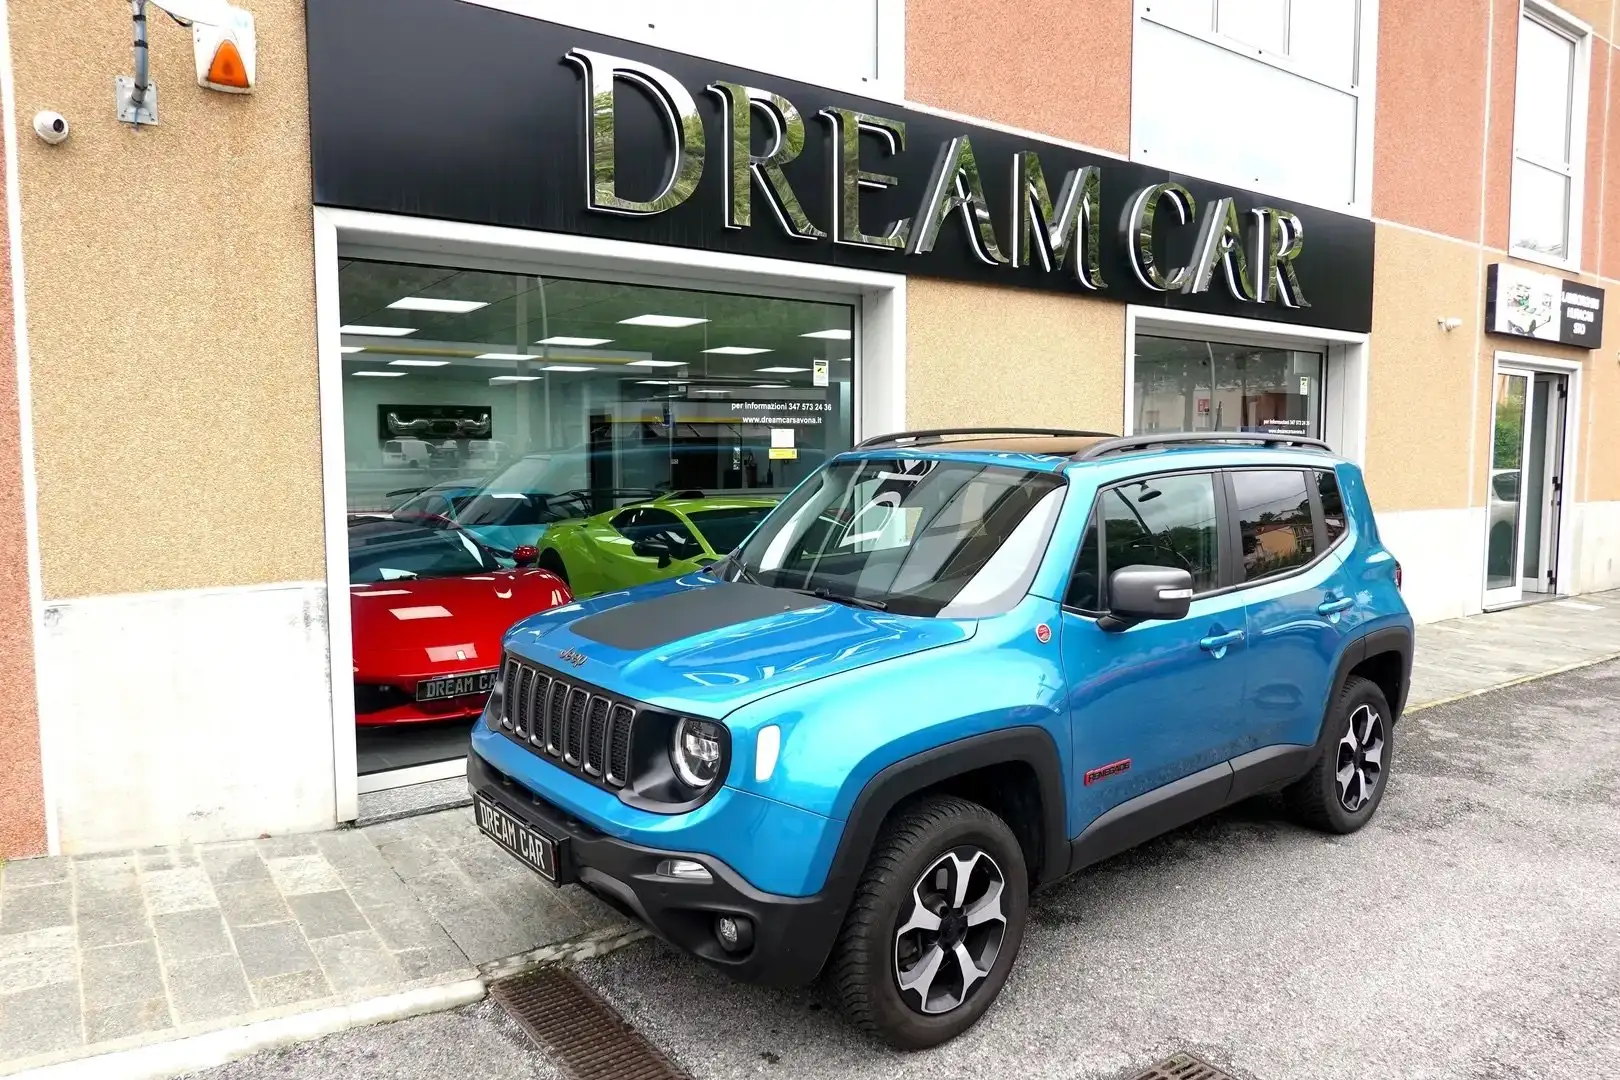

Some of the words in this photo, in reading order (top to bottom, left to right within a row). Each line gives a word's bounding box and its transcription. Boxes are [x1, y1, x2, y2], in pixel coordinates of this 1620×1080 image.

[565, 47, 1108, 289] DREAM
[1125, 182, 1312, 308] CAR
[731, 402, 743, 411] per
[744, 402, 787, 410] informazioni
[801, 403, 813, 411] 573
[742, 416, 822, 424] www.dreamcarsavona.it
[426, 676, 473, 698] DREAM
[478, 672, 497, 690] CA
[479, 801, 517, 850] DREAM
[519, 828, 546, 870] CAR
